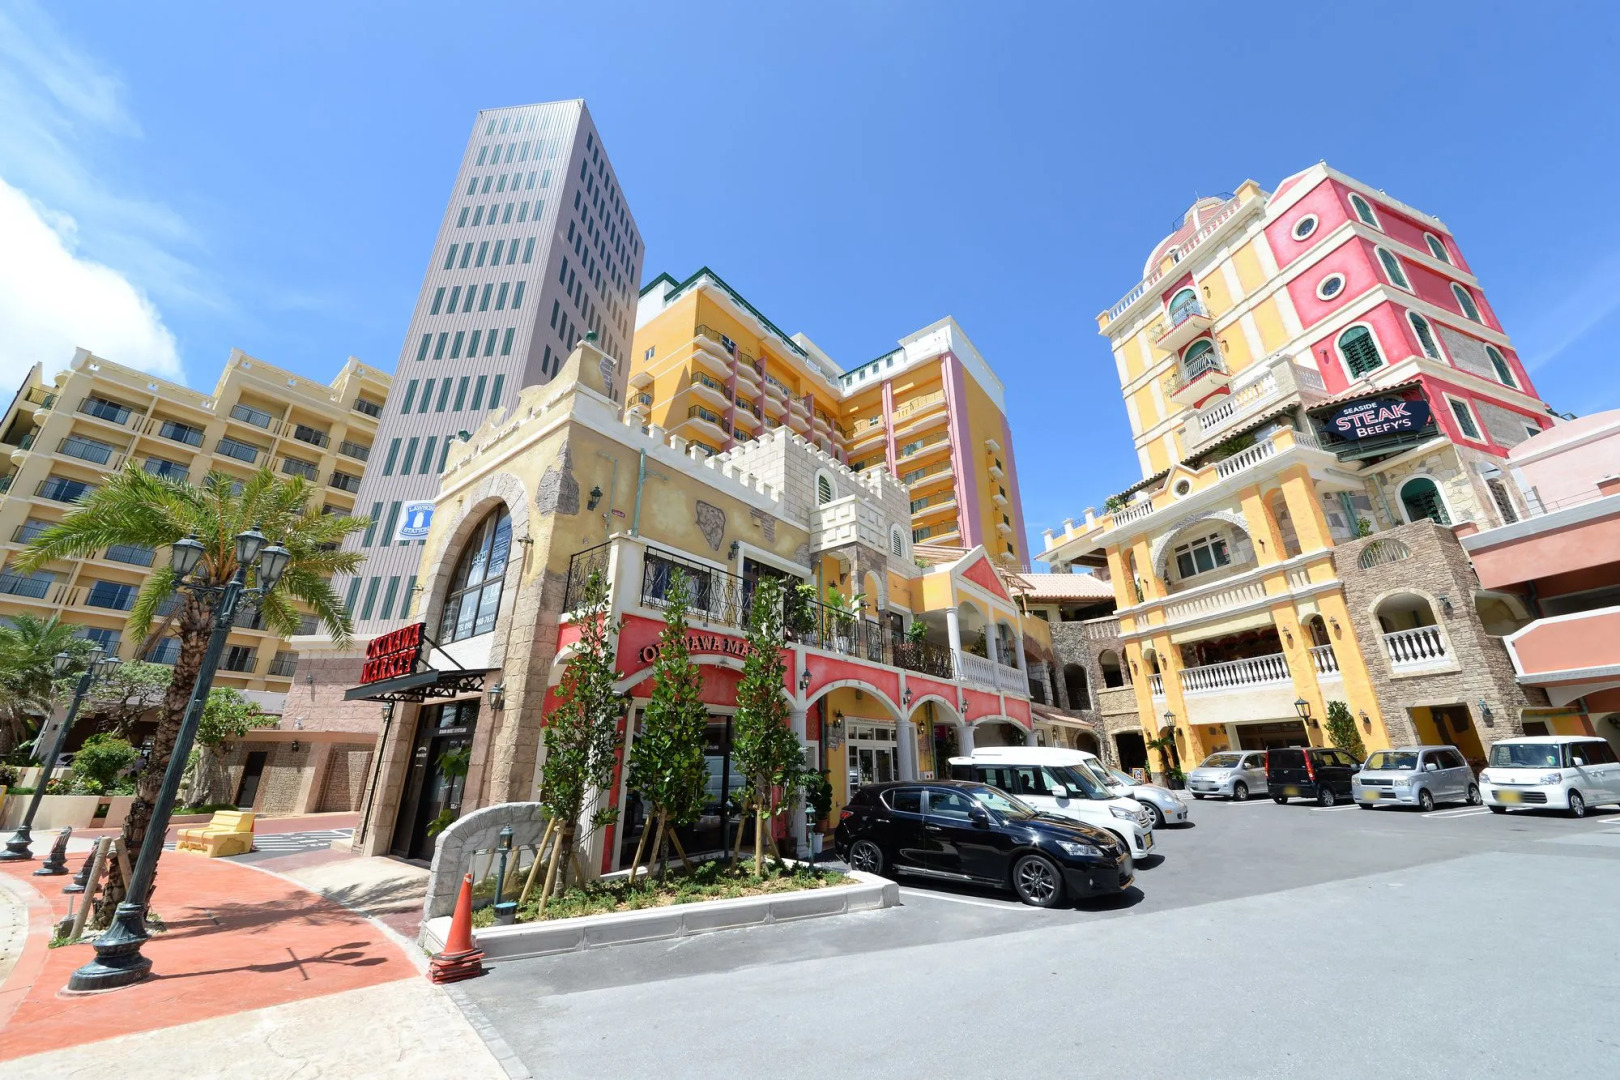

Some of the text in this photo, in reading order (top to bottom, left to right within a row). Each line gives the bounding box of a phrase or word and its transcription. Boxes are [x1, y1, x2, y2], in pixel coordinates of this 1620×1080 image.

[1335, 402, 1412, 431] STEAK
[1343, 402, 1378, 415] SEASIDE
[1356, 418, 1412, 438] BEEFY'S
[365, 623, 421, 660] OKINAWA
[360, 649, 417, 684] MARKET
